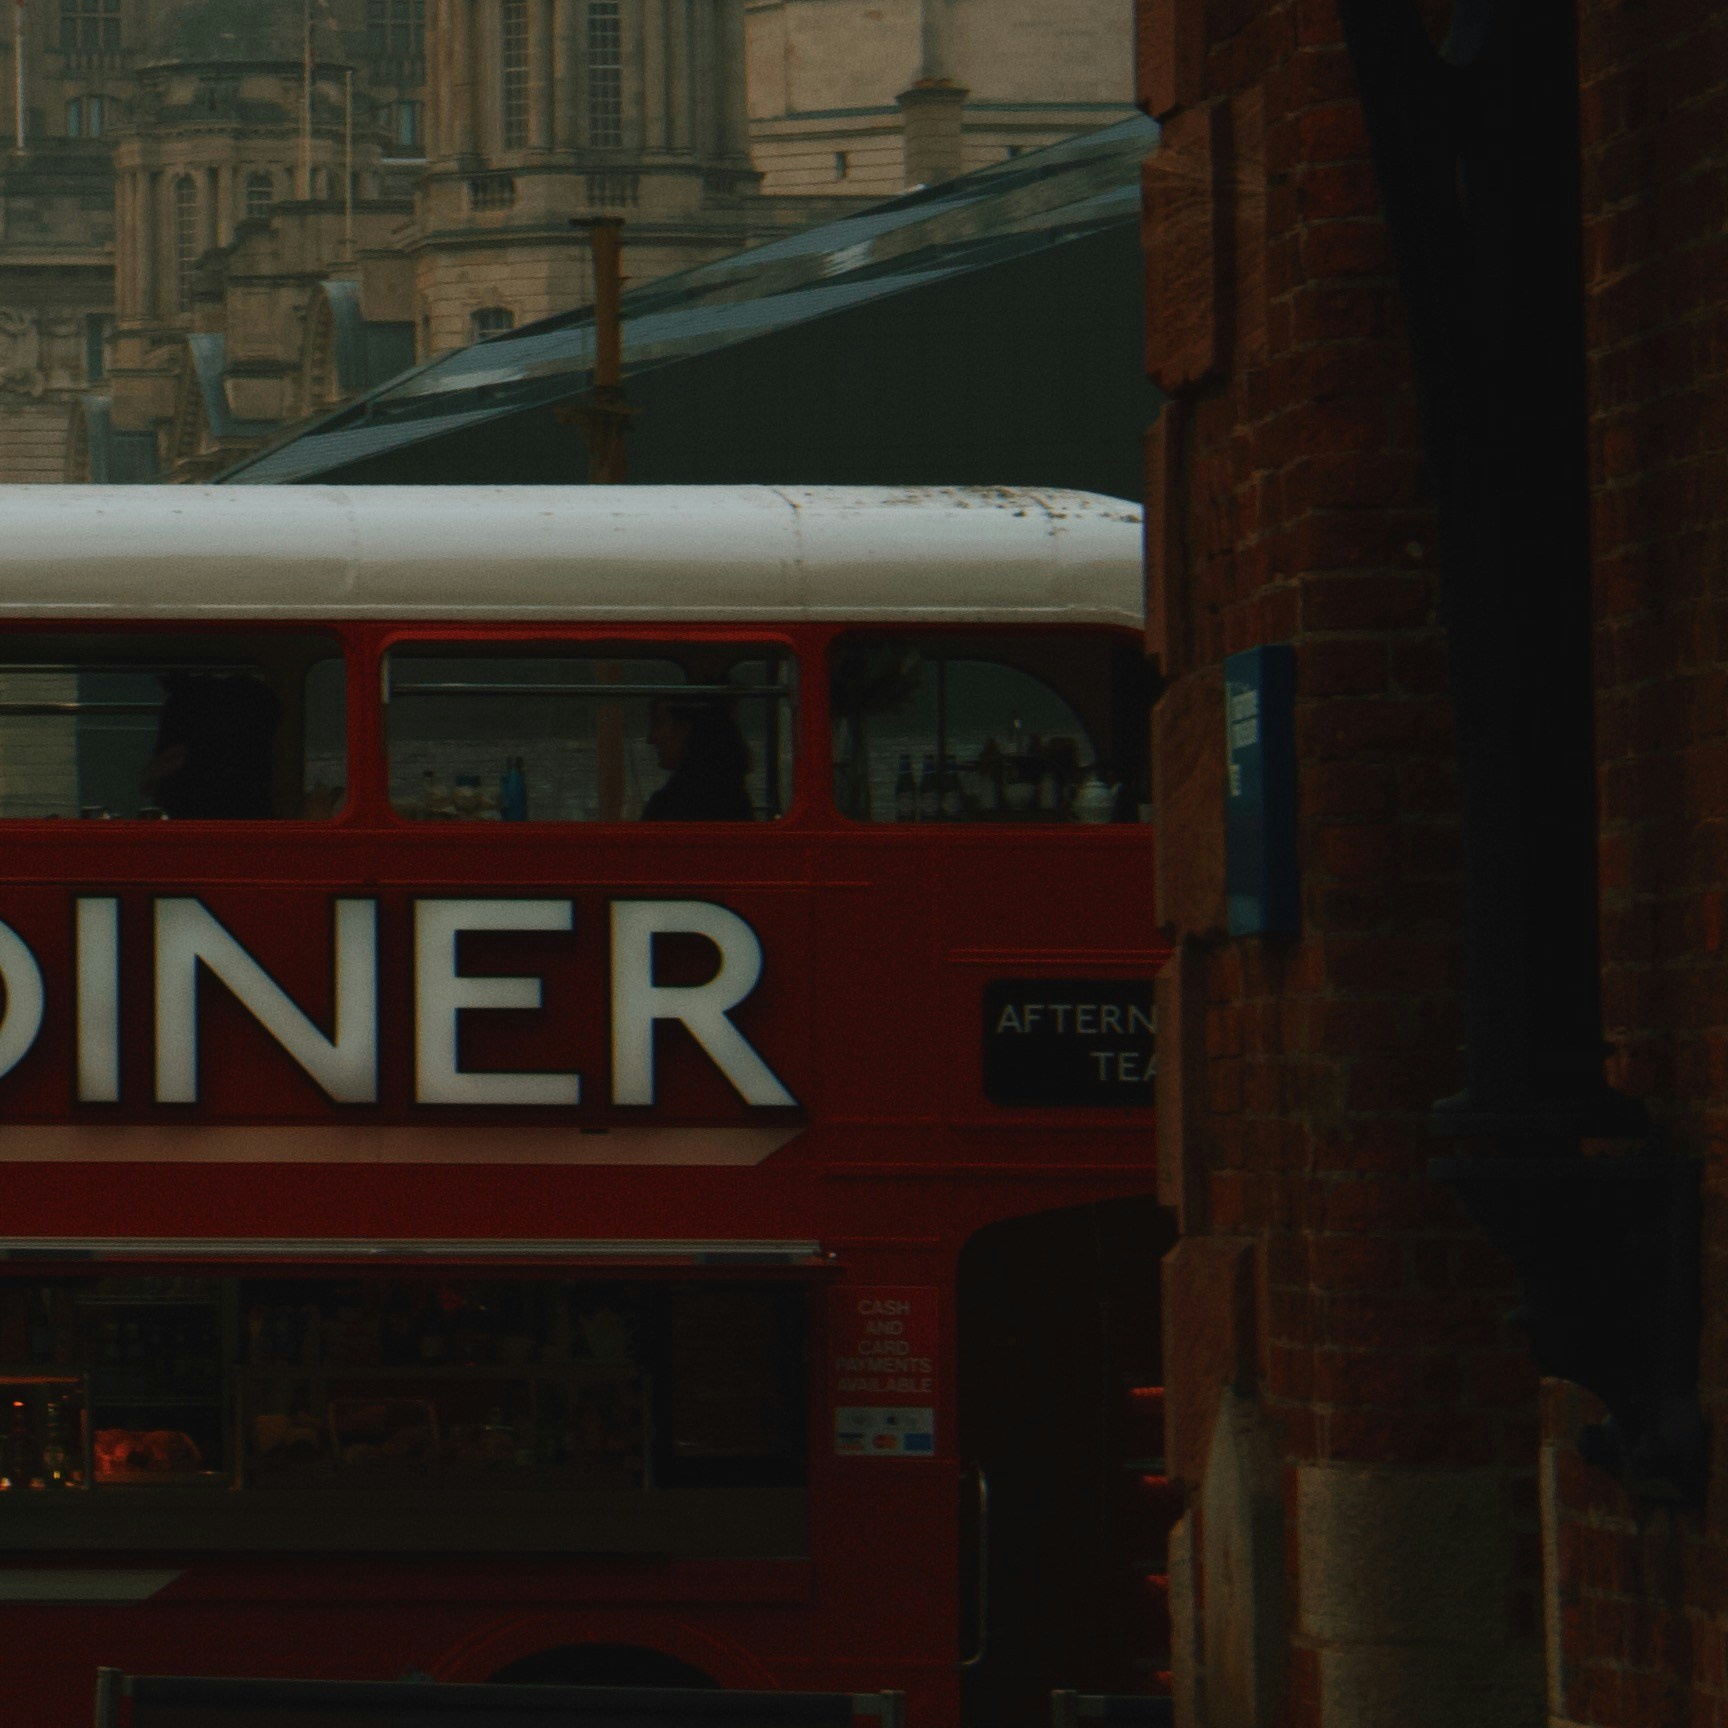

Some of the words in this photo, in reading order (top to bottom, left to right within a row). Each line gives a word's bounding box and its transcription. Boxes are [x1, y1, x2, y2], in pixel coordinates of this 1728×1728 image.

[858, 1299, 911, 1315] CASH
[865, 1320, 904, 1335] AND
[858, 1339, 910, 1356] CARD
[836, 1357, 933, 1373] PAYMENTS
[837, 1378, 933, 1393] AVAILABLE
